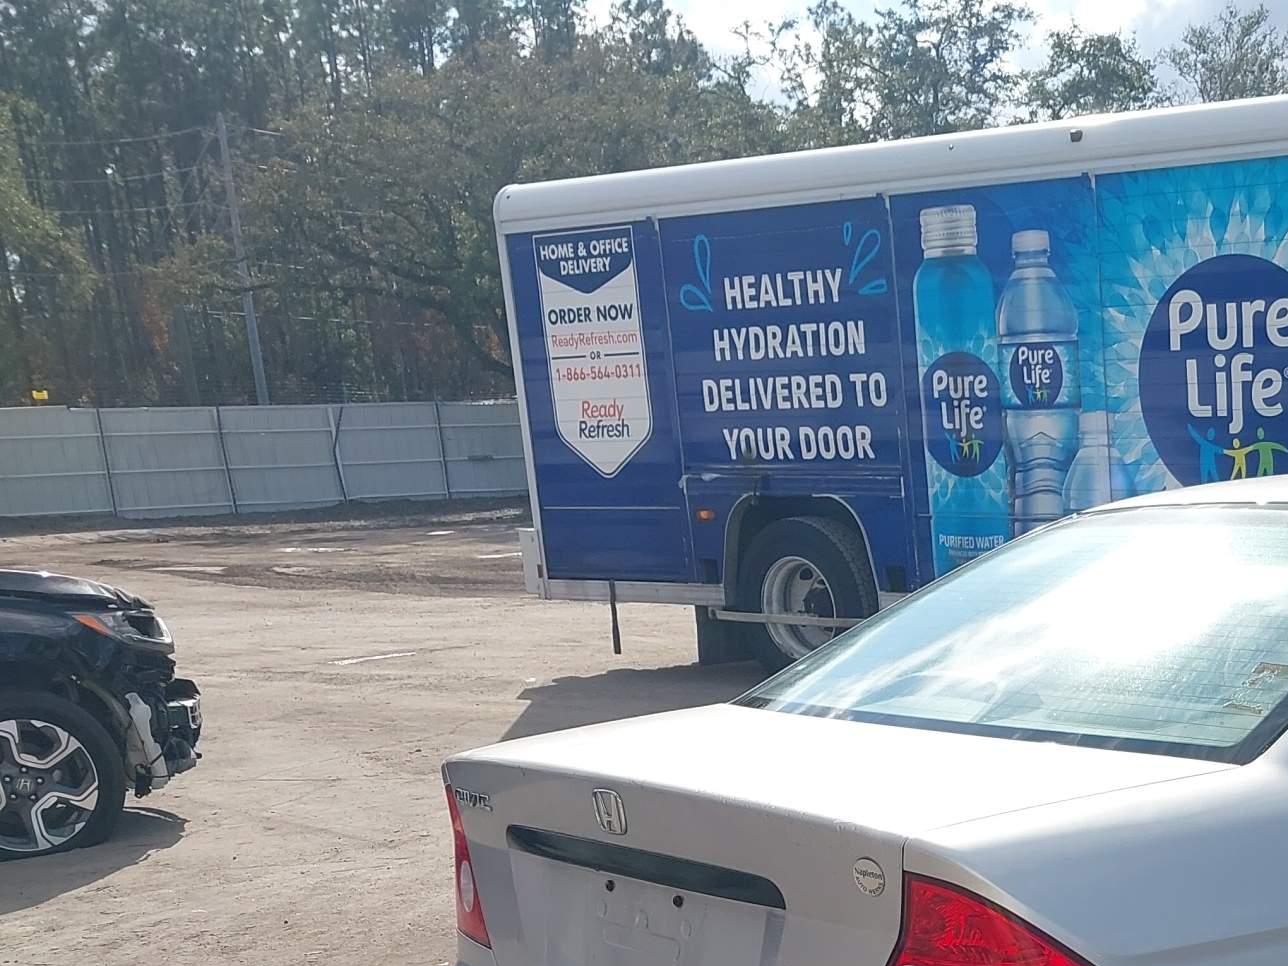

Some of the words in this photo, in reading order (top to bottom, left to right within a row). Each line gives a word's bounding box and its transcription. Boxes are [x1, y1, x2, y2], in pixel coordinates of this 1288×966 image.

[540, 243, 575, 261] HOME
[589, 237, 629, 255] OFFICE
[559, 256, 611, 276] DELIVERY
[724, 268, 842, 310] HEALTHY
[547, 306, 592, 326] ORDER
[596, 303, 633, 322] NOW
[551, 331, 638, 350] ReadyRefresh.com
[713, 320, 865, 361] HYDRATION
[590, 350, 601, 360] OR
[1018, 346, 1054, 365] Pure
[556, 364, 641, 382] 1-866-564-0311
[702, 374, 843, 413] DELIVERED
[849, 372, 887, 408] TO
[932, 370, 988, 399] Pure
[581, 399, 624, 421] Ready
[579, 419, 630, 439] Refresh
[723, 427, 795, 460] YOUR
[799, 425, 875, 460] DOOR
[939, 533, 975, 549] PURIFIED
[975, 535, 1004, 549] WATER
